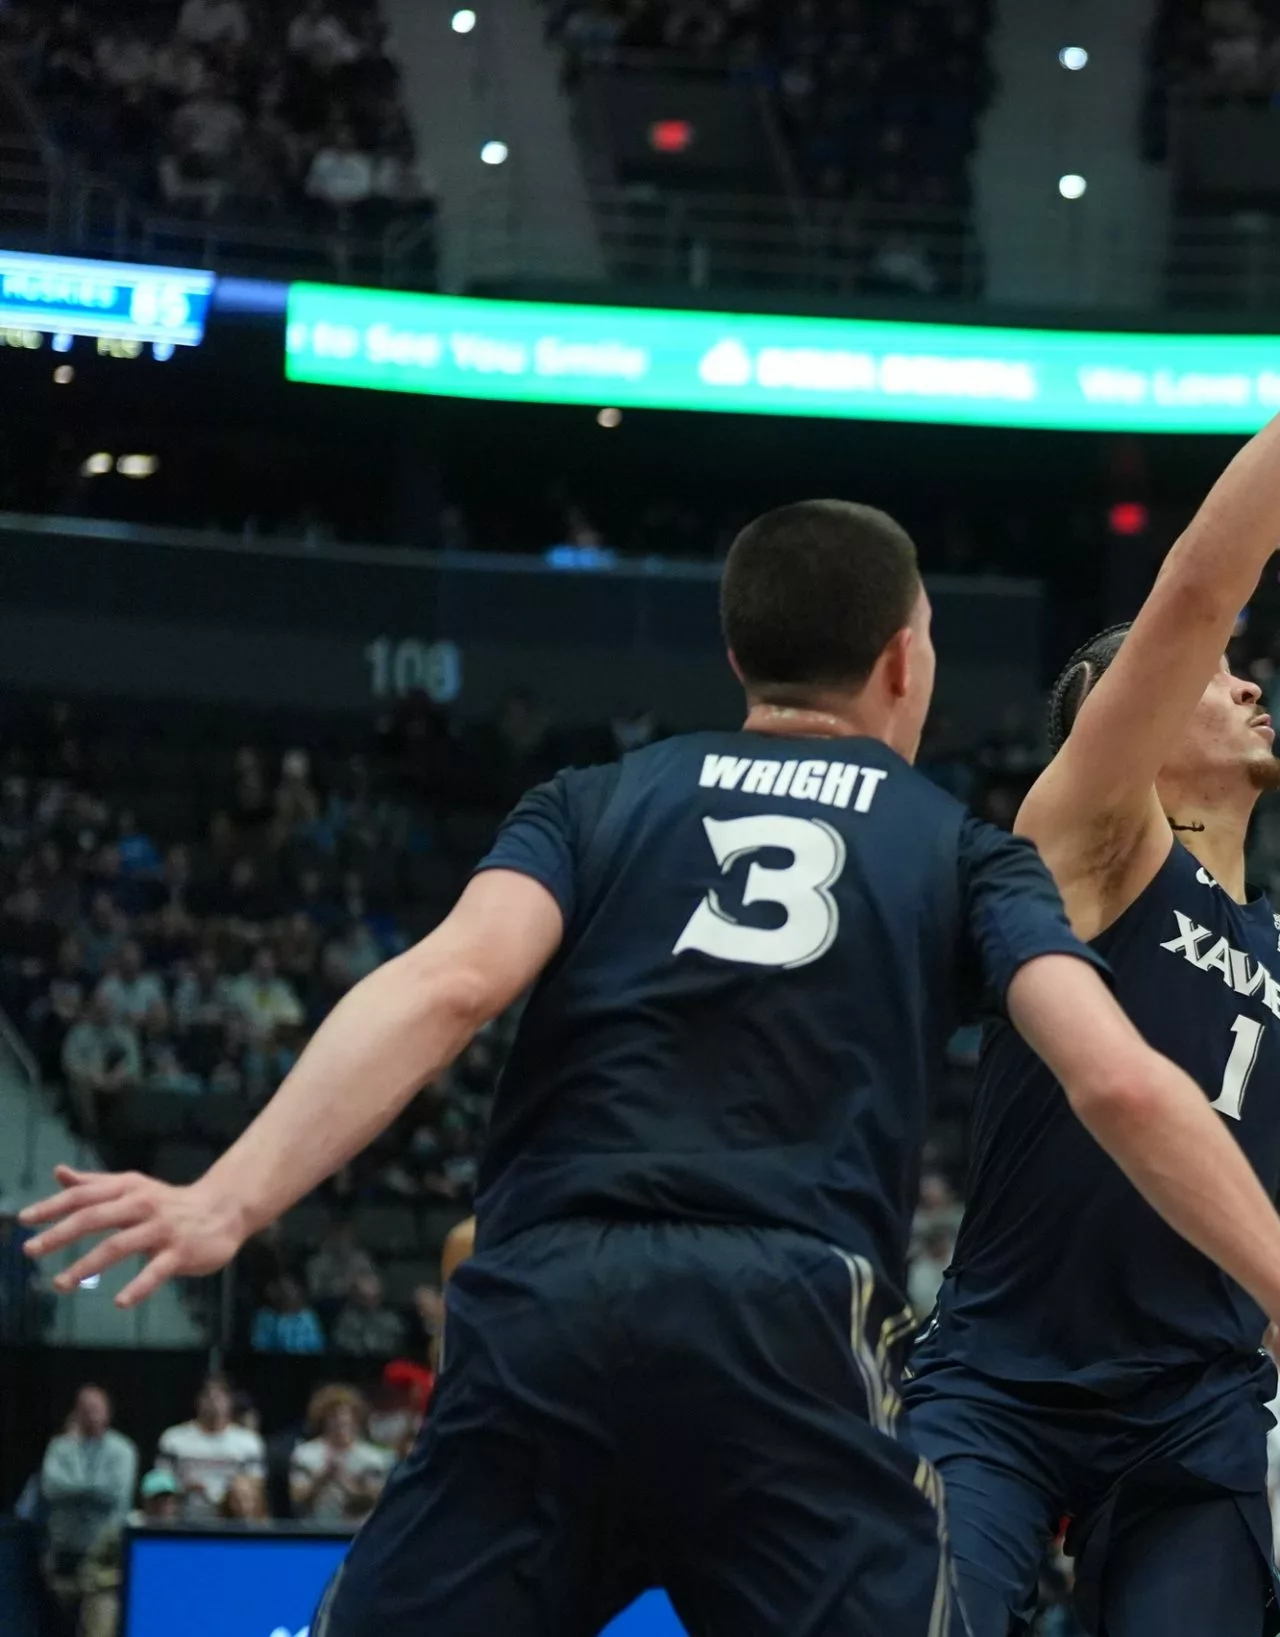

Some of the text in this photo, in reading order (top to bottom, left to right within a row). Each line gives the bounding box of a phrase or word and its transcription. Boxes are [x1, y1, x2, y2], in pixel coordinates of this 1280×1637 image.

[698, 754, 888, 813] WRIGHT
[672, 814, 847, 969] 3
[1210, 1014, 1266, 1121] 1
